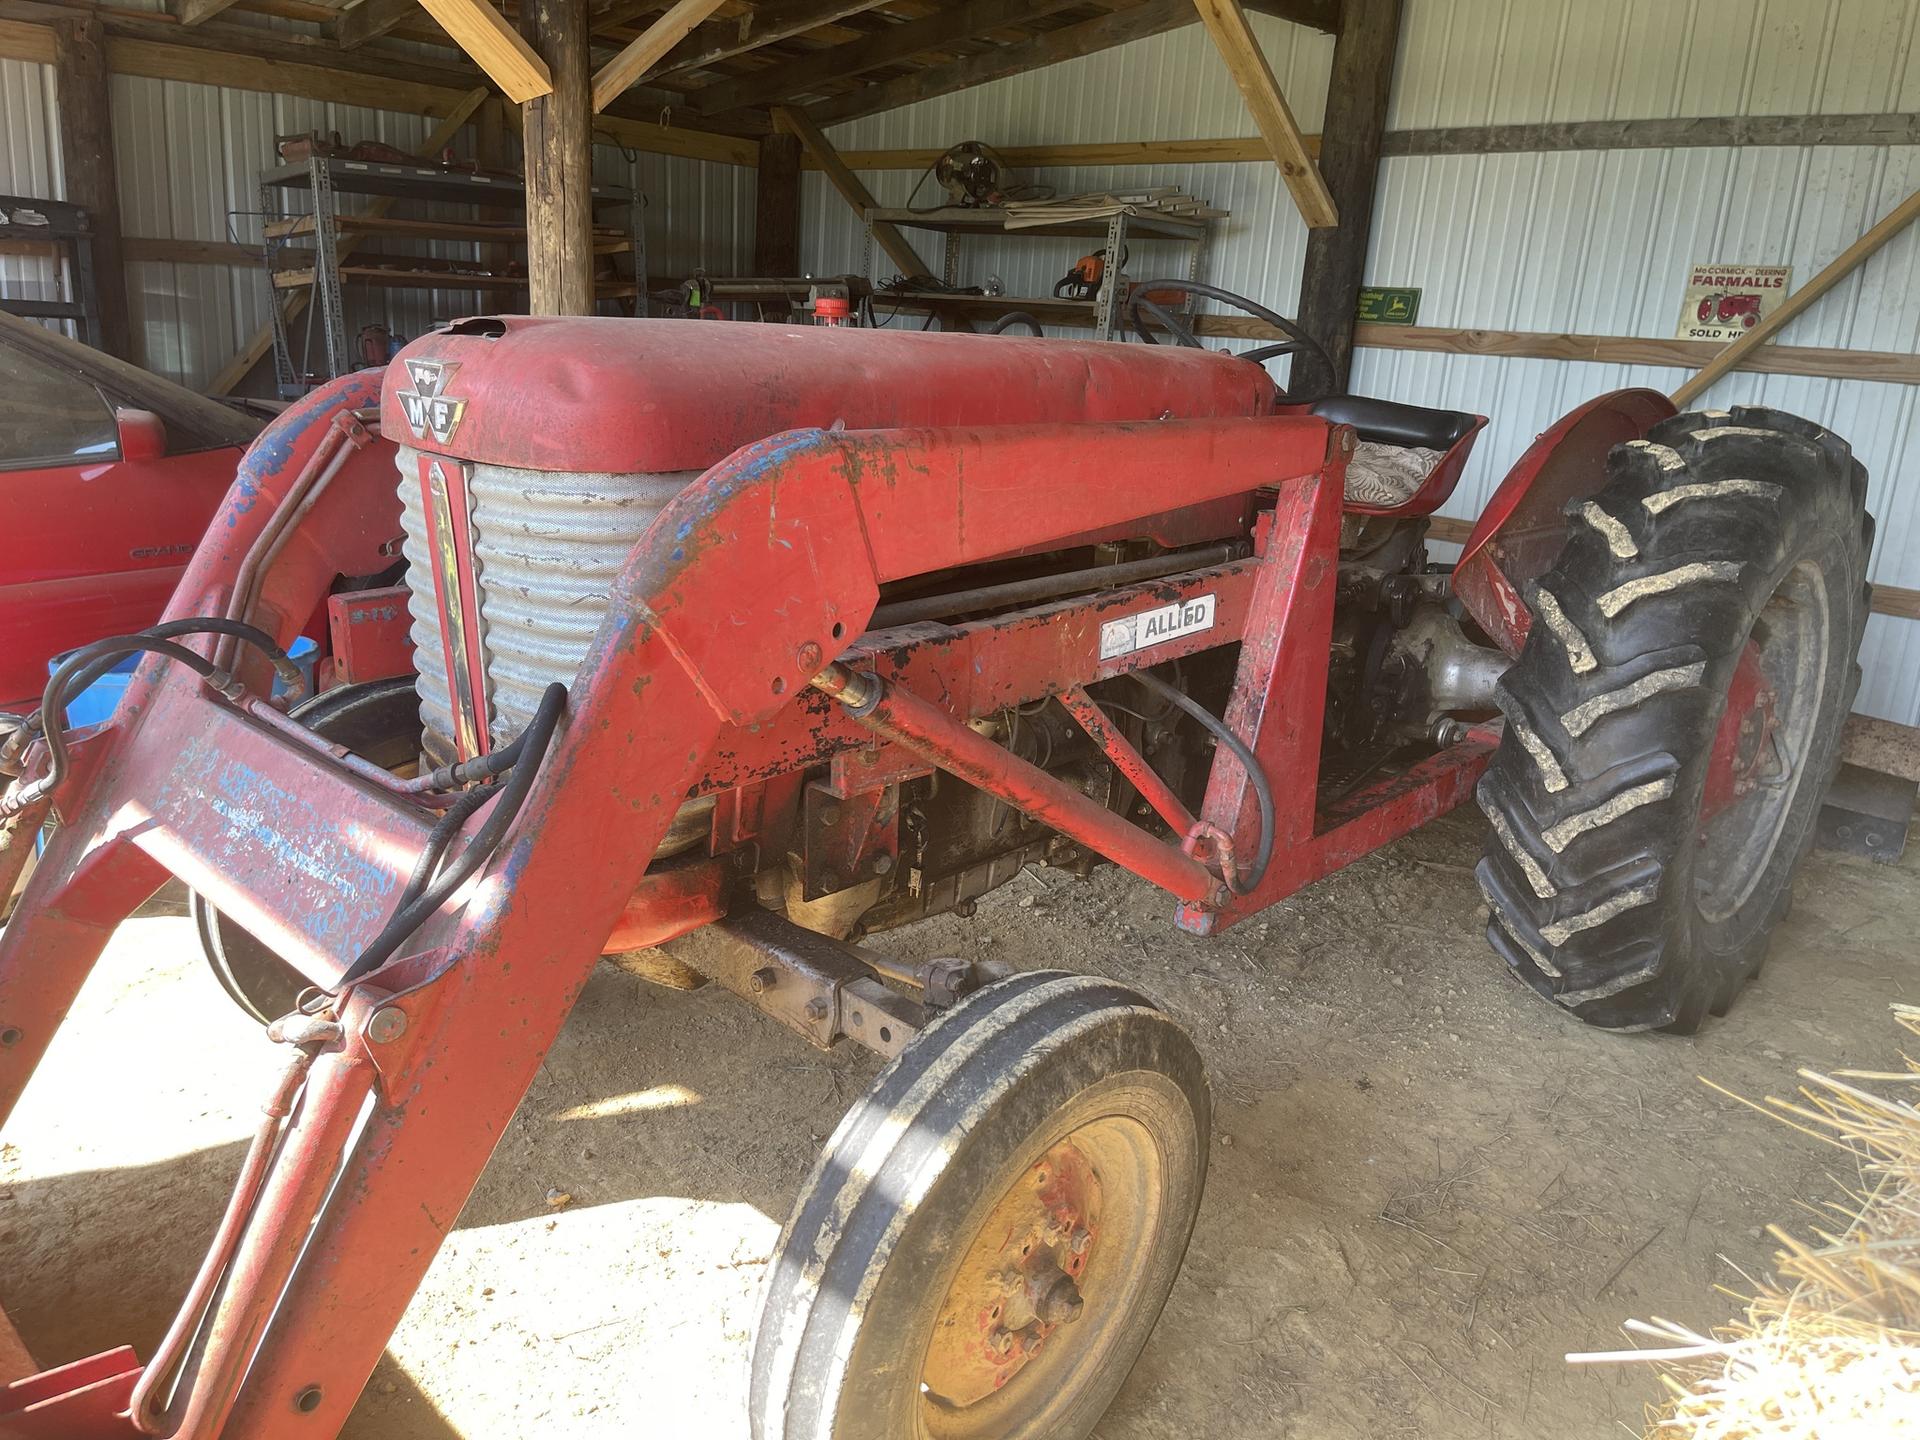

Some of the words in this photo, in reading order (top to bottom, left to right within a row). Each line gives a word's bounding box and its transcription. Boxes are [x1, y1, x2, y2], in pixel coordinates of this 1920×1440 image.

[1755, 268, 1787, 276] DEERING
[1692, 275, 1783, 288] FARMALLS
[1689, 328, 1721, 338] SOLD
[1145, 604, 1206, 639] ALLIED
